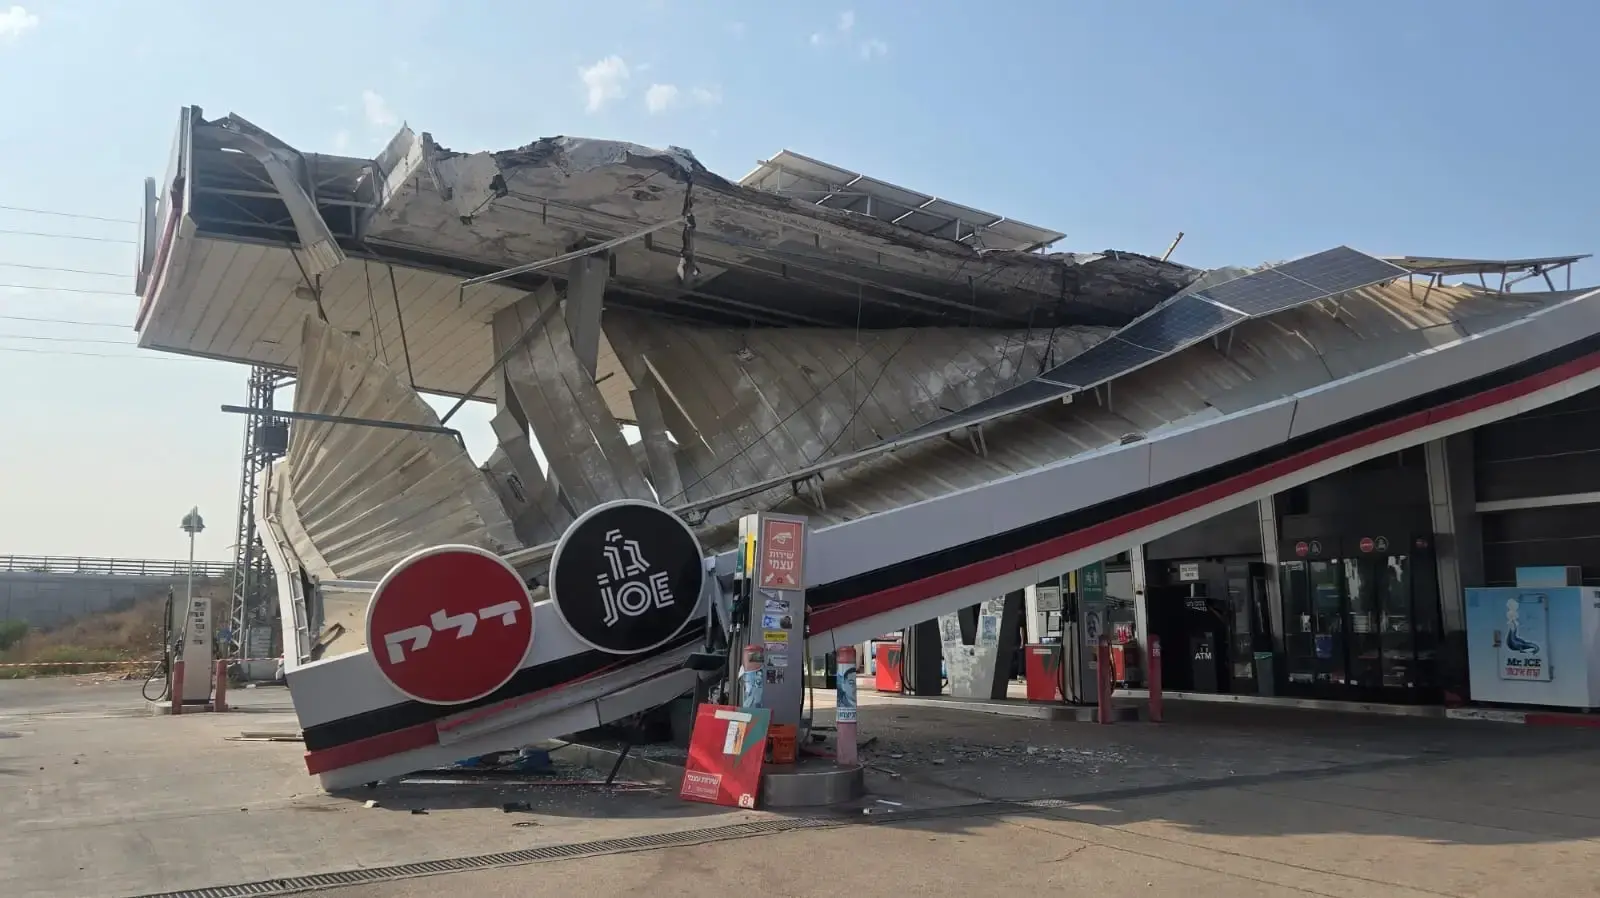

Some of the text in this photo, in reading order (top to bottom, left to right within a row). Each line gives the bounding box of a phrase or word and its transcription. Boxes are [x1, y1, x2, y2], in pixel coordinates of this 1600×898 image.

[768, 551, 794, 560] שירות
[768, 559, 794, 570] עצמי
[597, 570, 675, 627] JOE
[383, 600, 522, 665] דלק
[1194, 652, 1212, 660] ATM
[1507, 657, 1541, 667] Mr. ICE
[742, 795, 750, 805] 8
